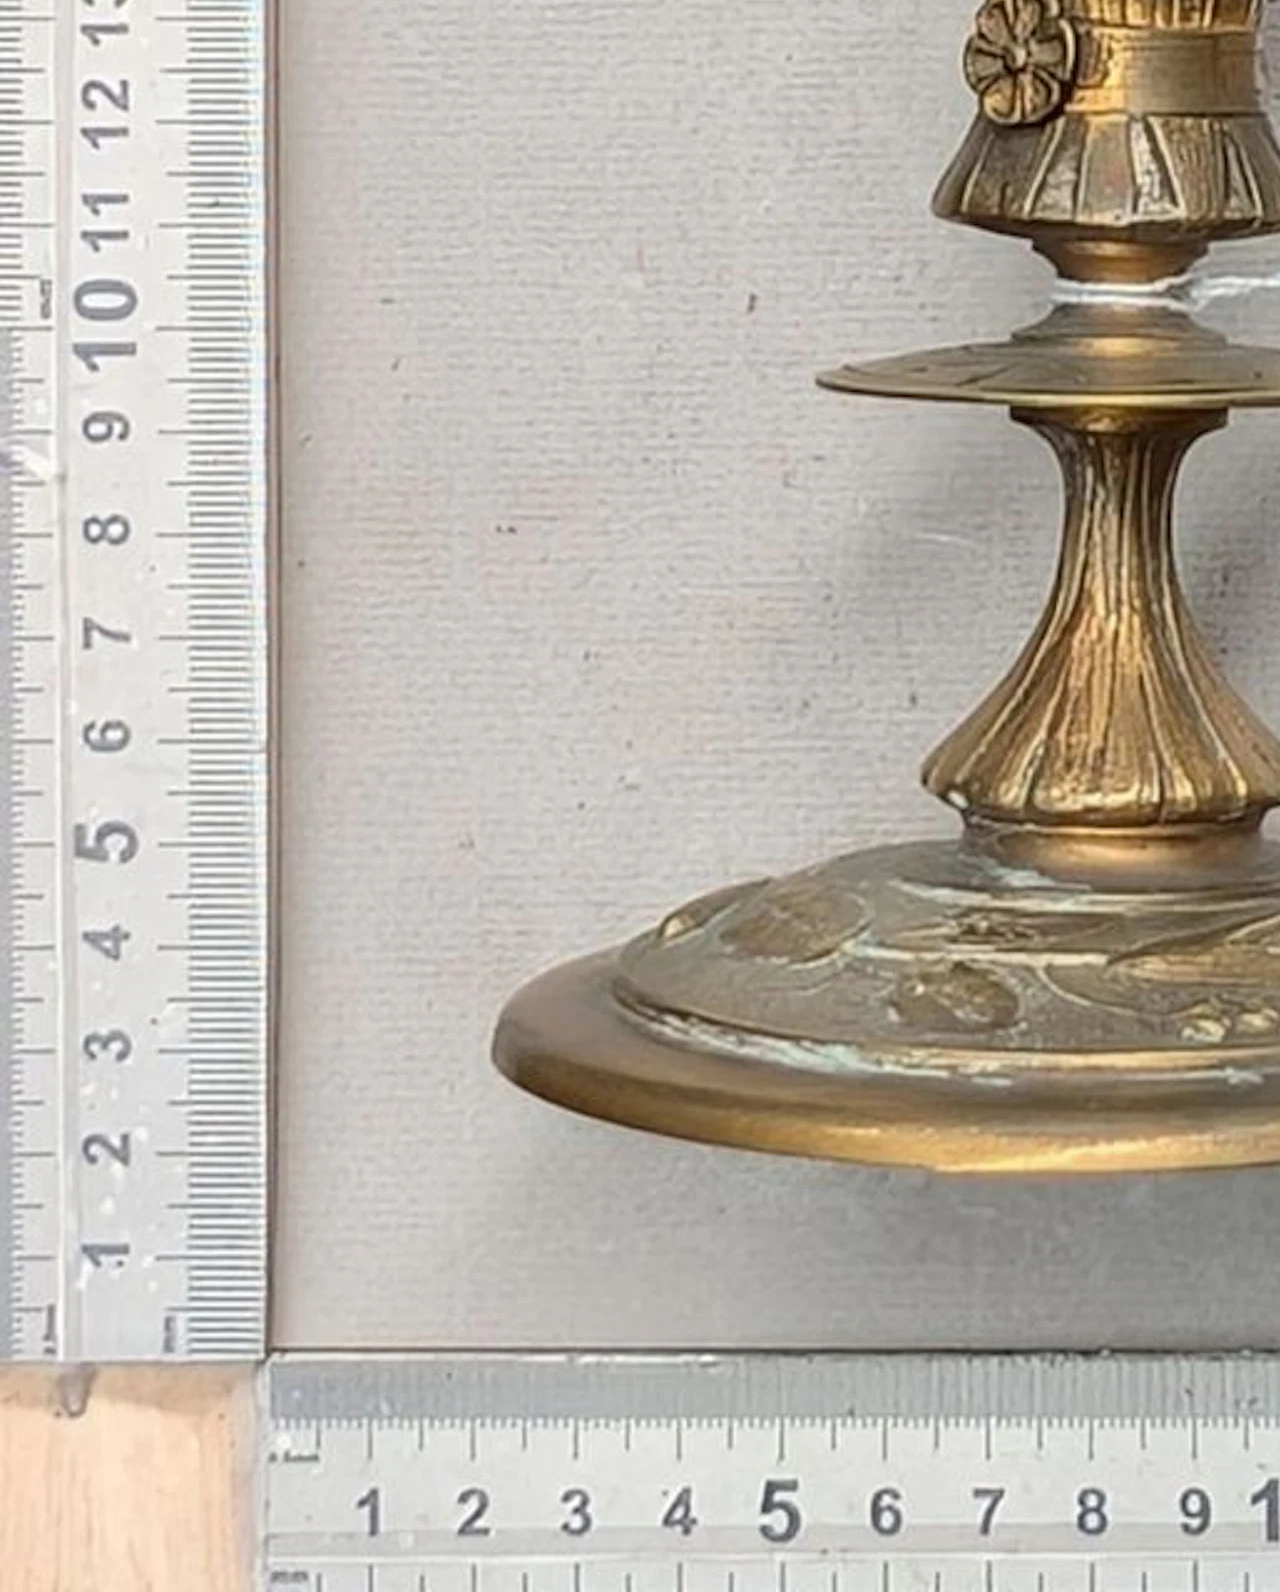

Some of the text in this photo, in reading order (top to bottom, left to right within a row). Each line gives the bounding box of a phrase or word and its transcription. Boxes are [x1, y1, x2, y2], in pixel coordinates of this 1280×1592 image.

[79, 78, 130, 151] 12
[79, 192, 131, 254] 11
[70, 278, 139, 373] 10
[81, 410, 131, 445] 9
[81, 513, 132, 547] 8
[81, 616, 132, 651] 7
[81, 719, 132, 754] 6
[71, 820, 140, 865] 5
[81, 924, 132, 962] 4
[81, 1029, 133, 1064] 3
[79, 1132, 132, 1168] 2
[79, 1243, 131, 1269] 1
[355, 1486, 381, 1539] 1
[455, 1487, 491, 1539] 2
[559, 1487, 593, 1539] 3
[661, 1486, 699, 1537] 4
[758, 1478, 803, 1546] 5
[869, 1486, 904, 1538] 6
[971, 1487, 1006, 1538] 7
[1075, 1486, 1109, 1539] 8
[1178, 1486, 1213, 1538] 9
